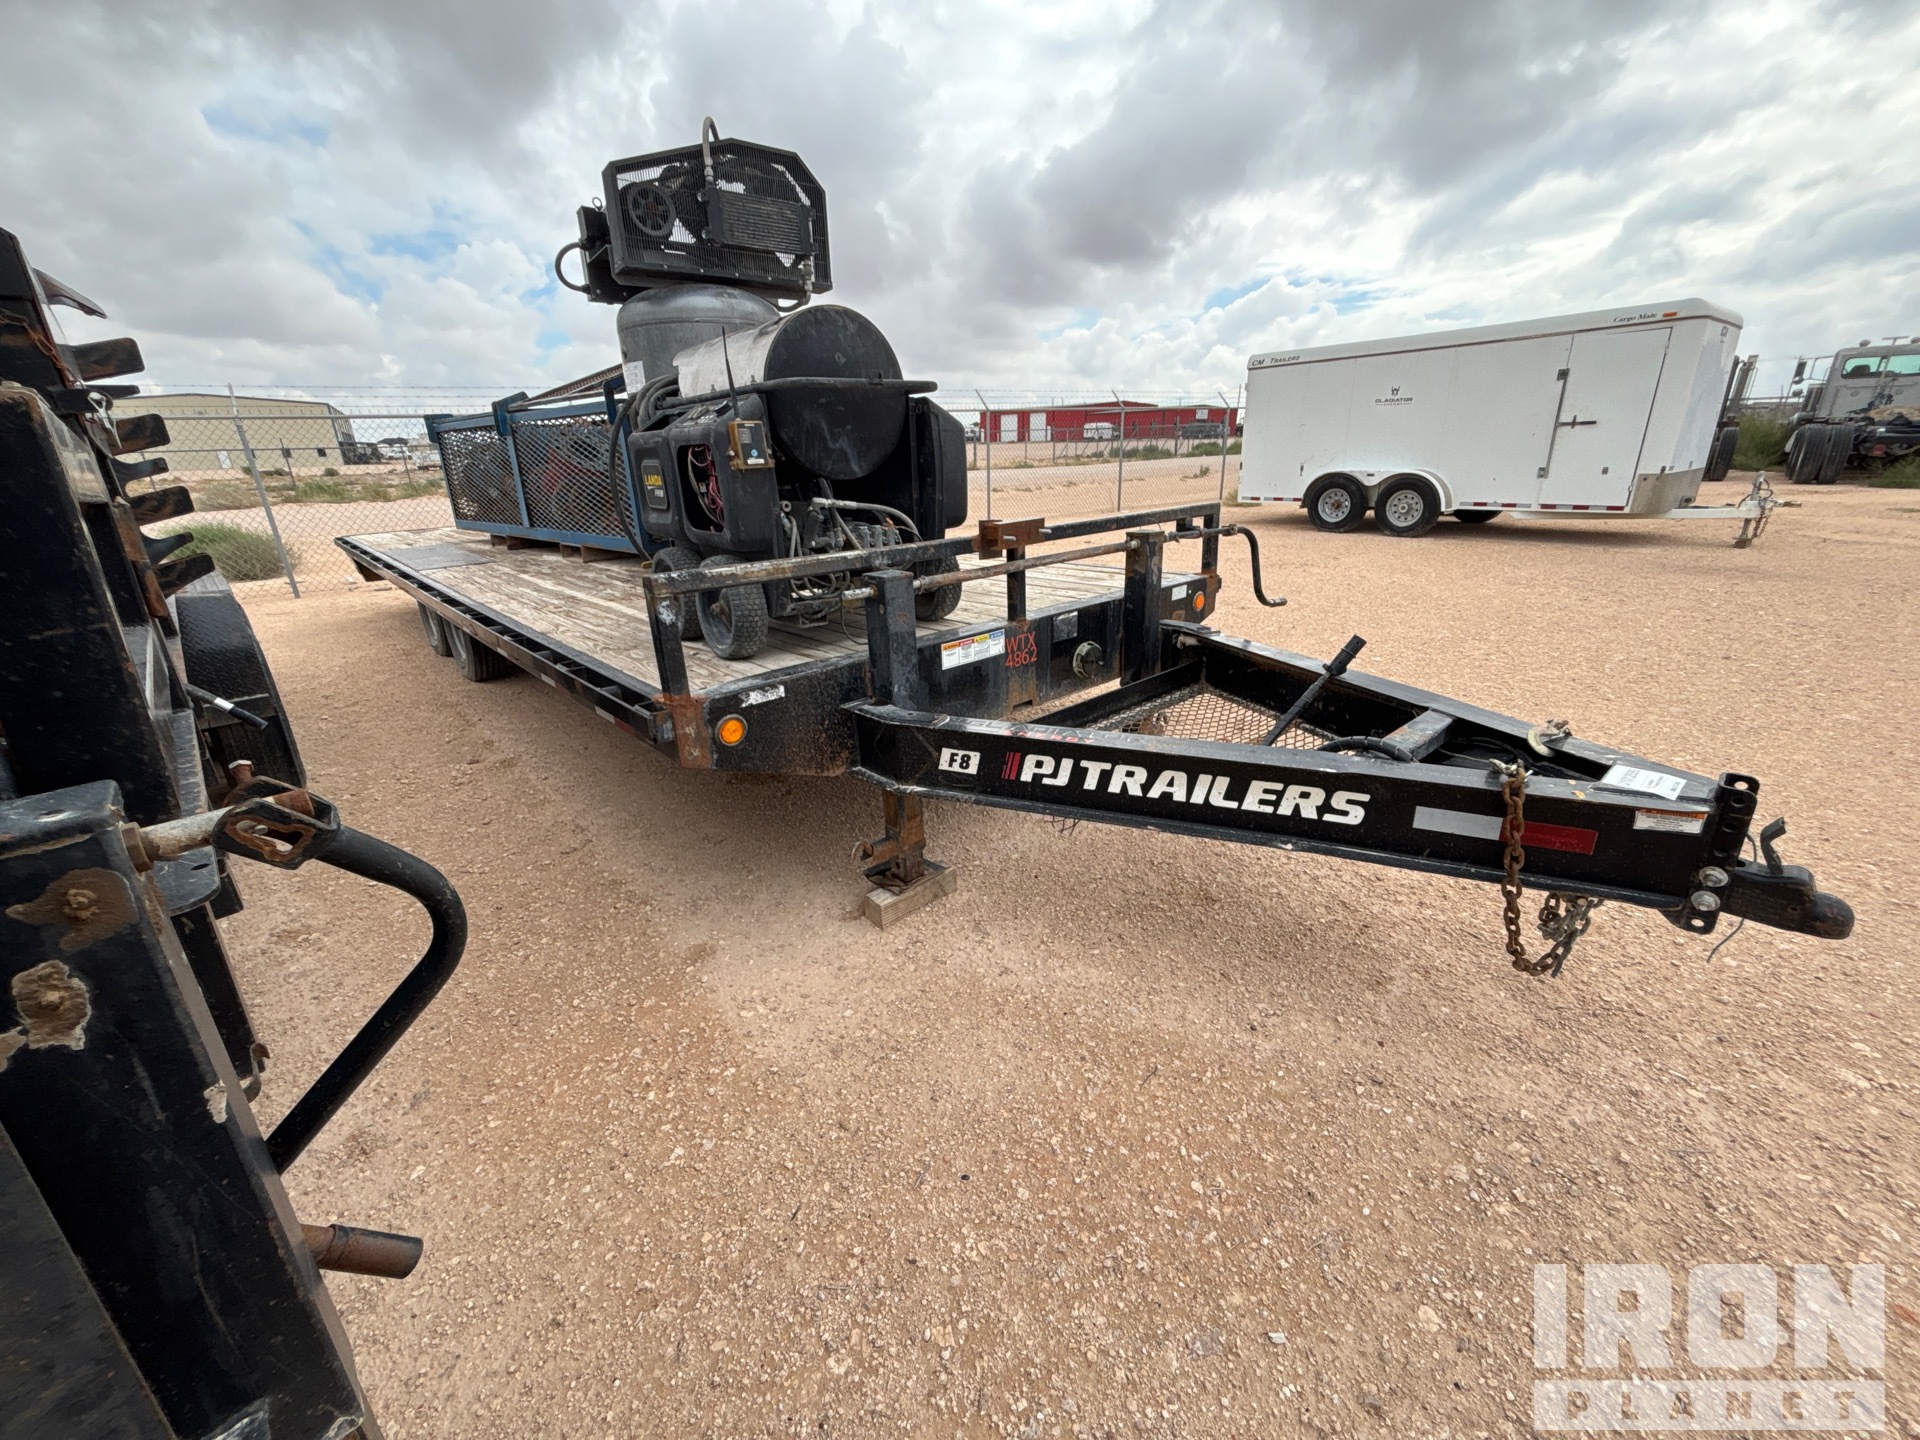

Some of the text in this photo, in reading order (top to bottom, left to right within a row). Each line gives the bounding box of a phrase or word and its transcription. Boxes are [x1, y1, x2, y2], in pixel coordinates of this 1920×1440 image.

[1637, 312, 1658, 320] Mate
[1251, 358, 1265, 367] CM
[1005, 631, 1036, 654] WTX
[1005, 646, 1038, 669] 4862
[948, 752, 973, 770] F8
[1019, 753, 1372, 826] PJ TRAILERS
